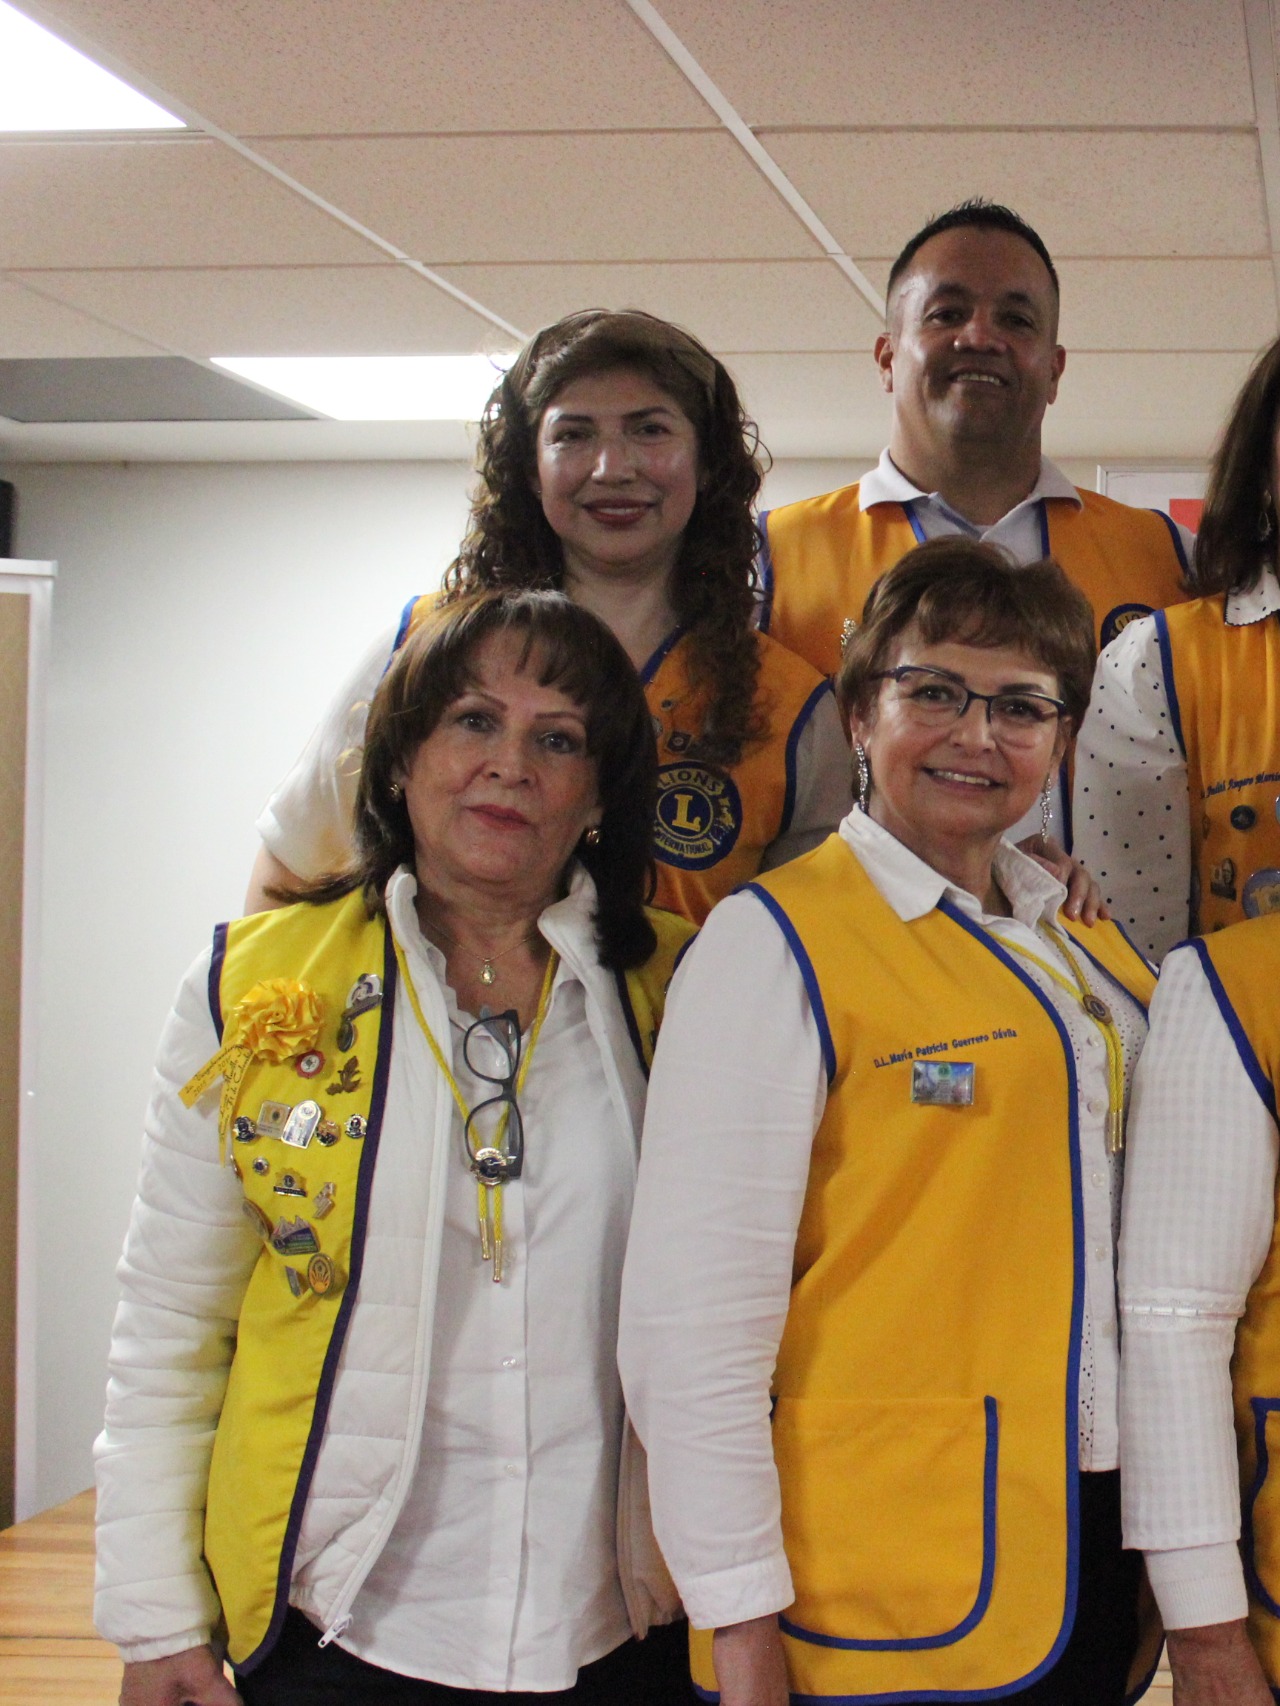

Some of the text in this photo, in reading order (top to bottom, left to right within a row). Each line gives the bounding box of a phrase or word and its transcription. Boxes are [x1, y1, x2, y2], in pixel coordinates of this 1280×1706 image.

[661, 770, 720, 792] LIONS
[672, 793, 701, 832] L
[655, 832, 712, 855] NTERNATIONAL
[916, 1042, 948, 1057] Patricia
[952, 1034, 989, 1049] Guerrero
